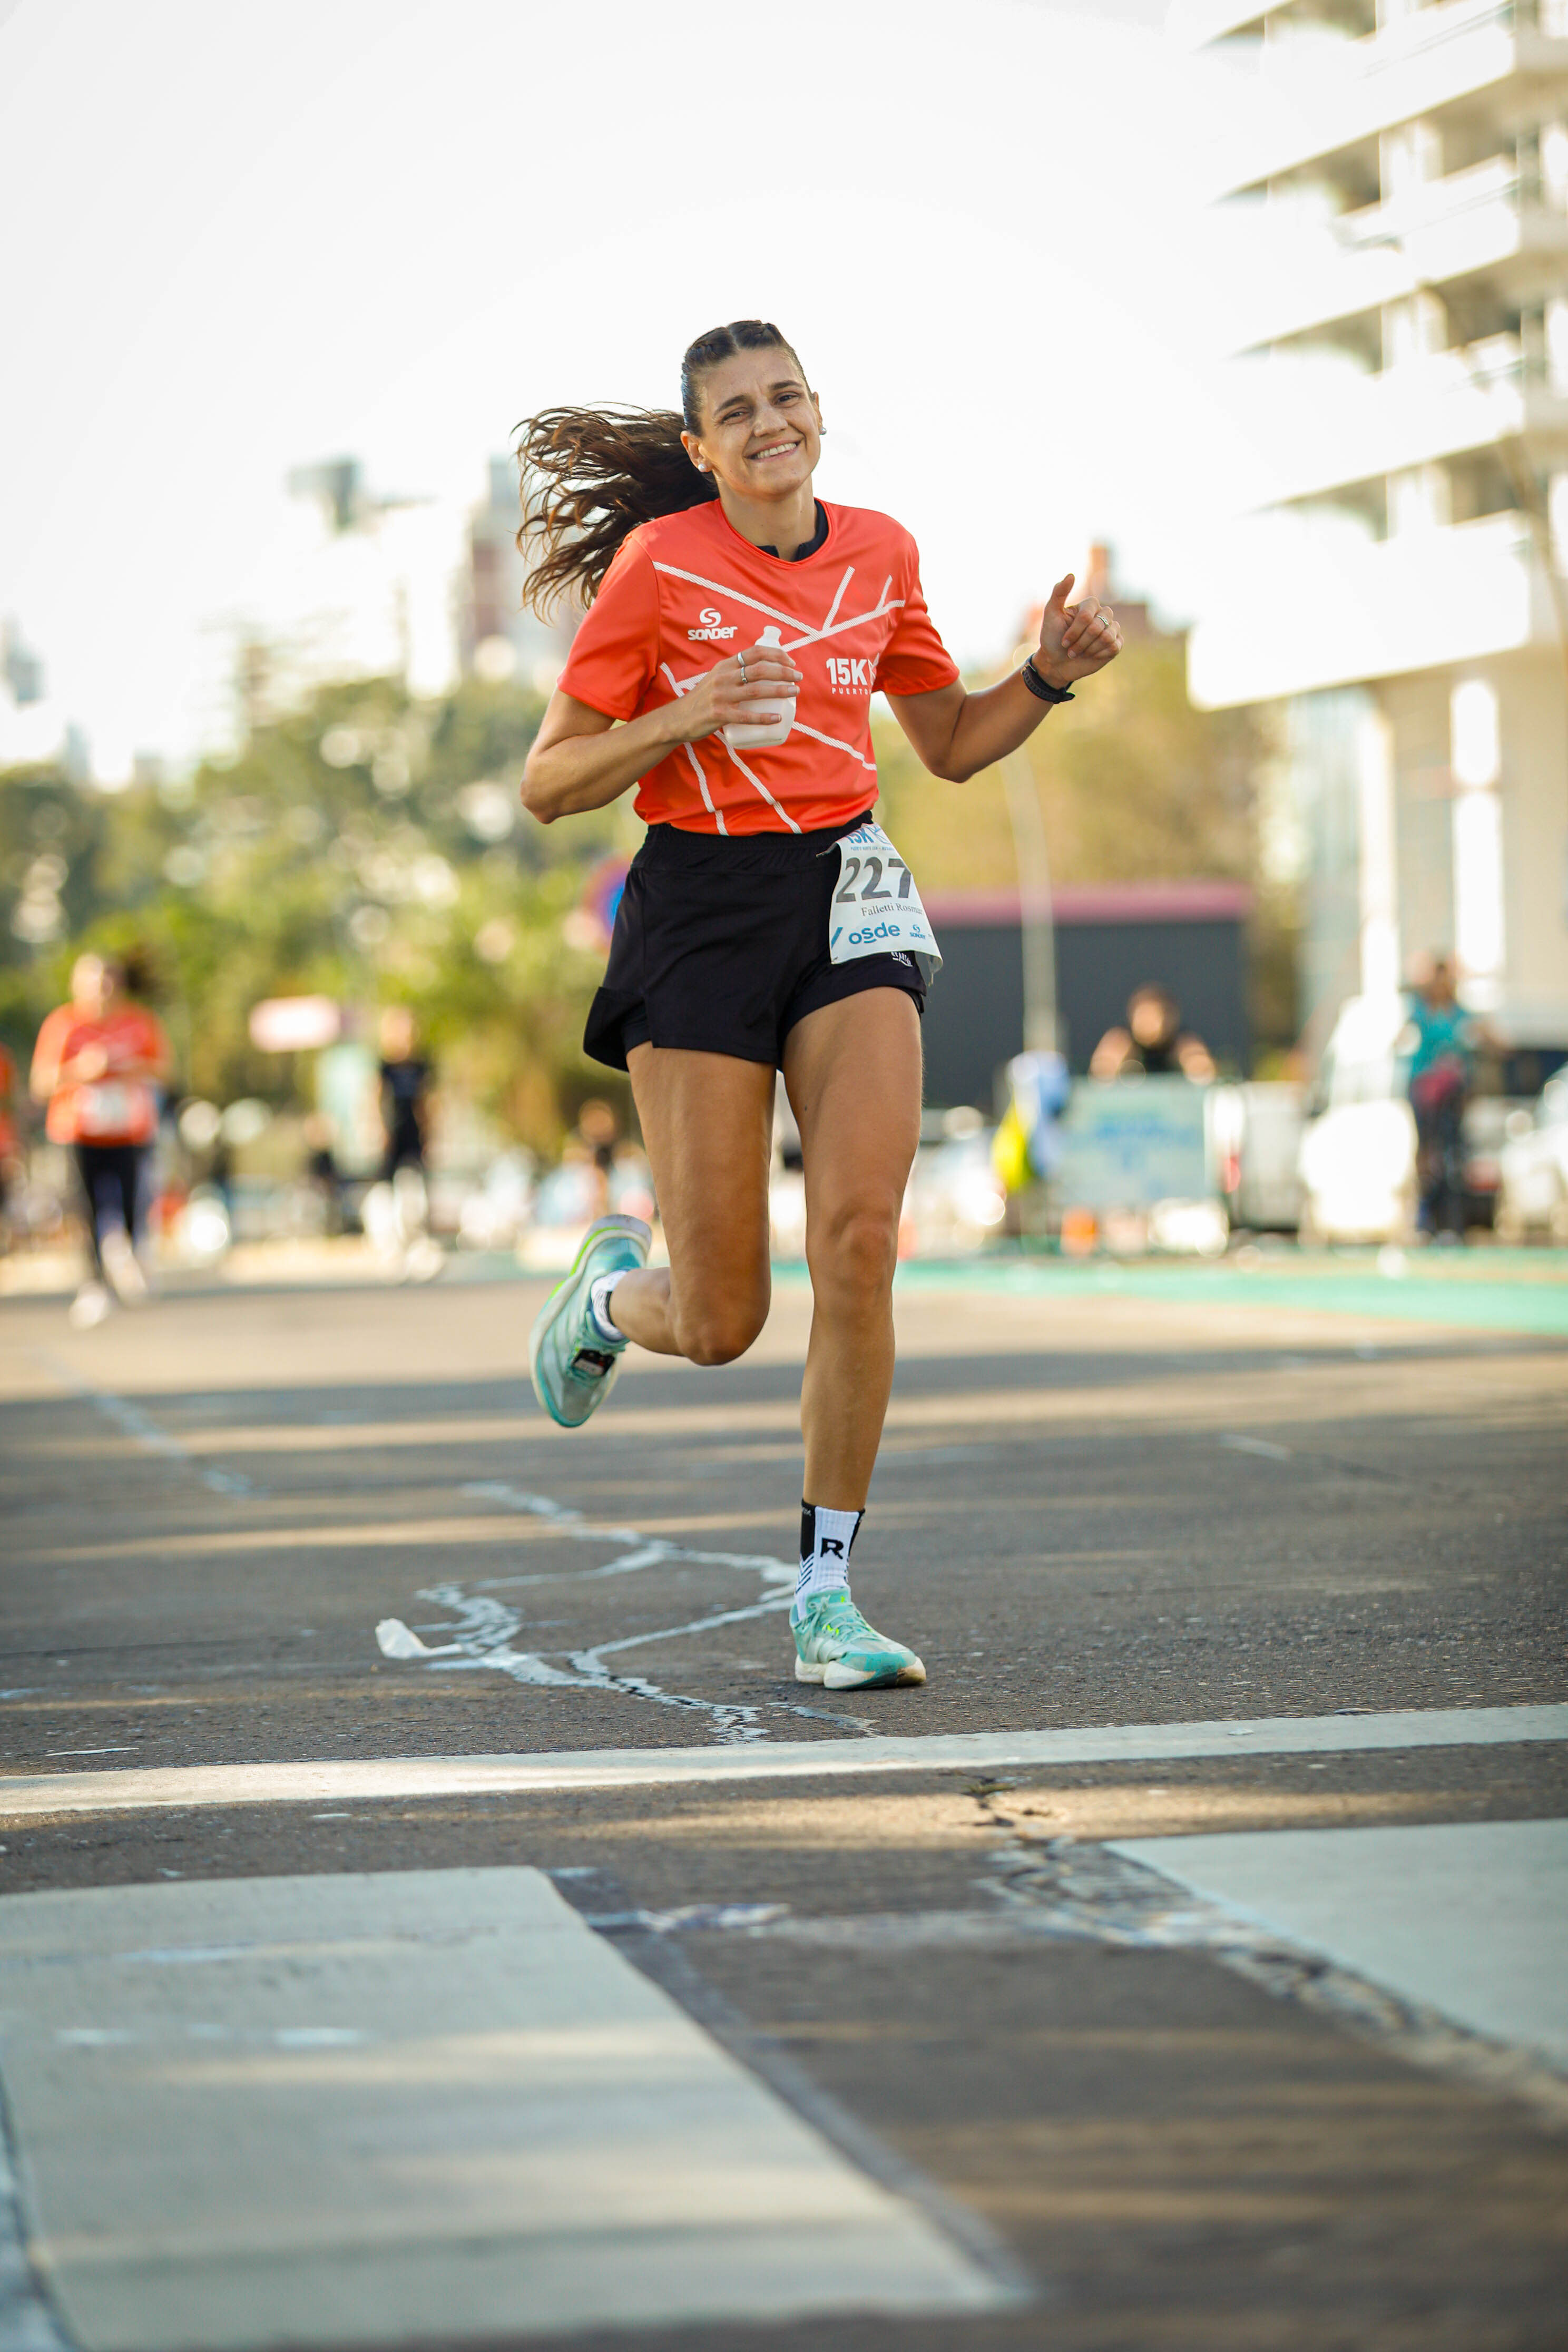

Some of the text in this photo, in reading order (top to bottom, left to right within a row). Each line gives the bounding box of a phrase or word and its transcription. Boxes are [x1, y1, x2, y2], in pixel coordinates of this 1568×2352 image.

[826, 658, 867, 685] 15K
[836, 857, 911, 903] 227
[861, 903, 894, 916] Falletti
[849, 922, 900, 944] osde
